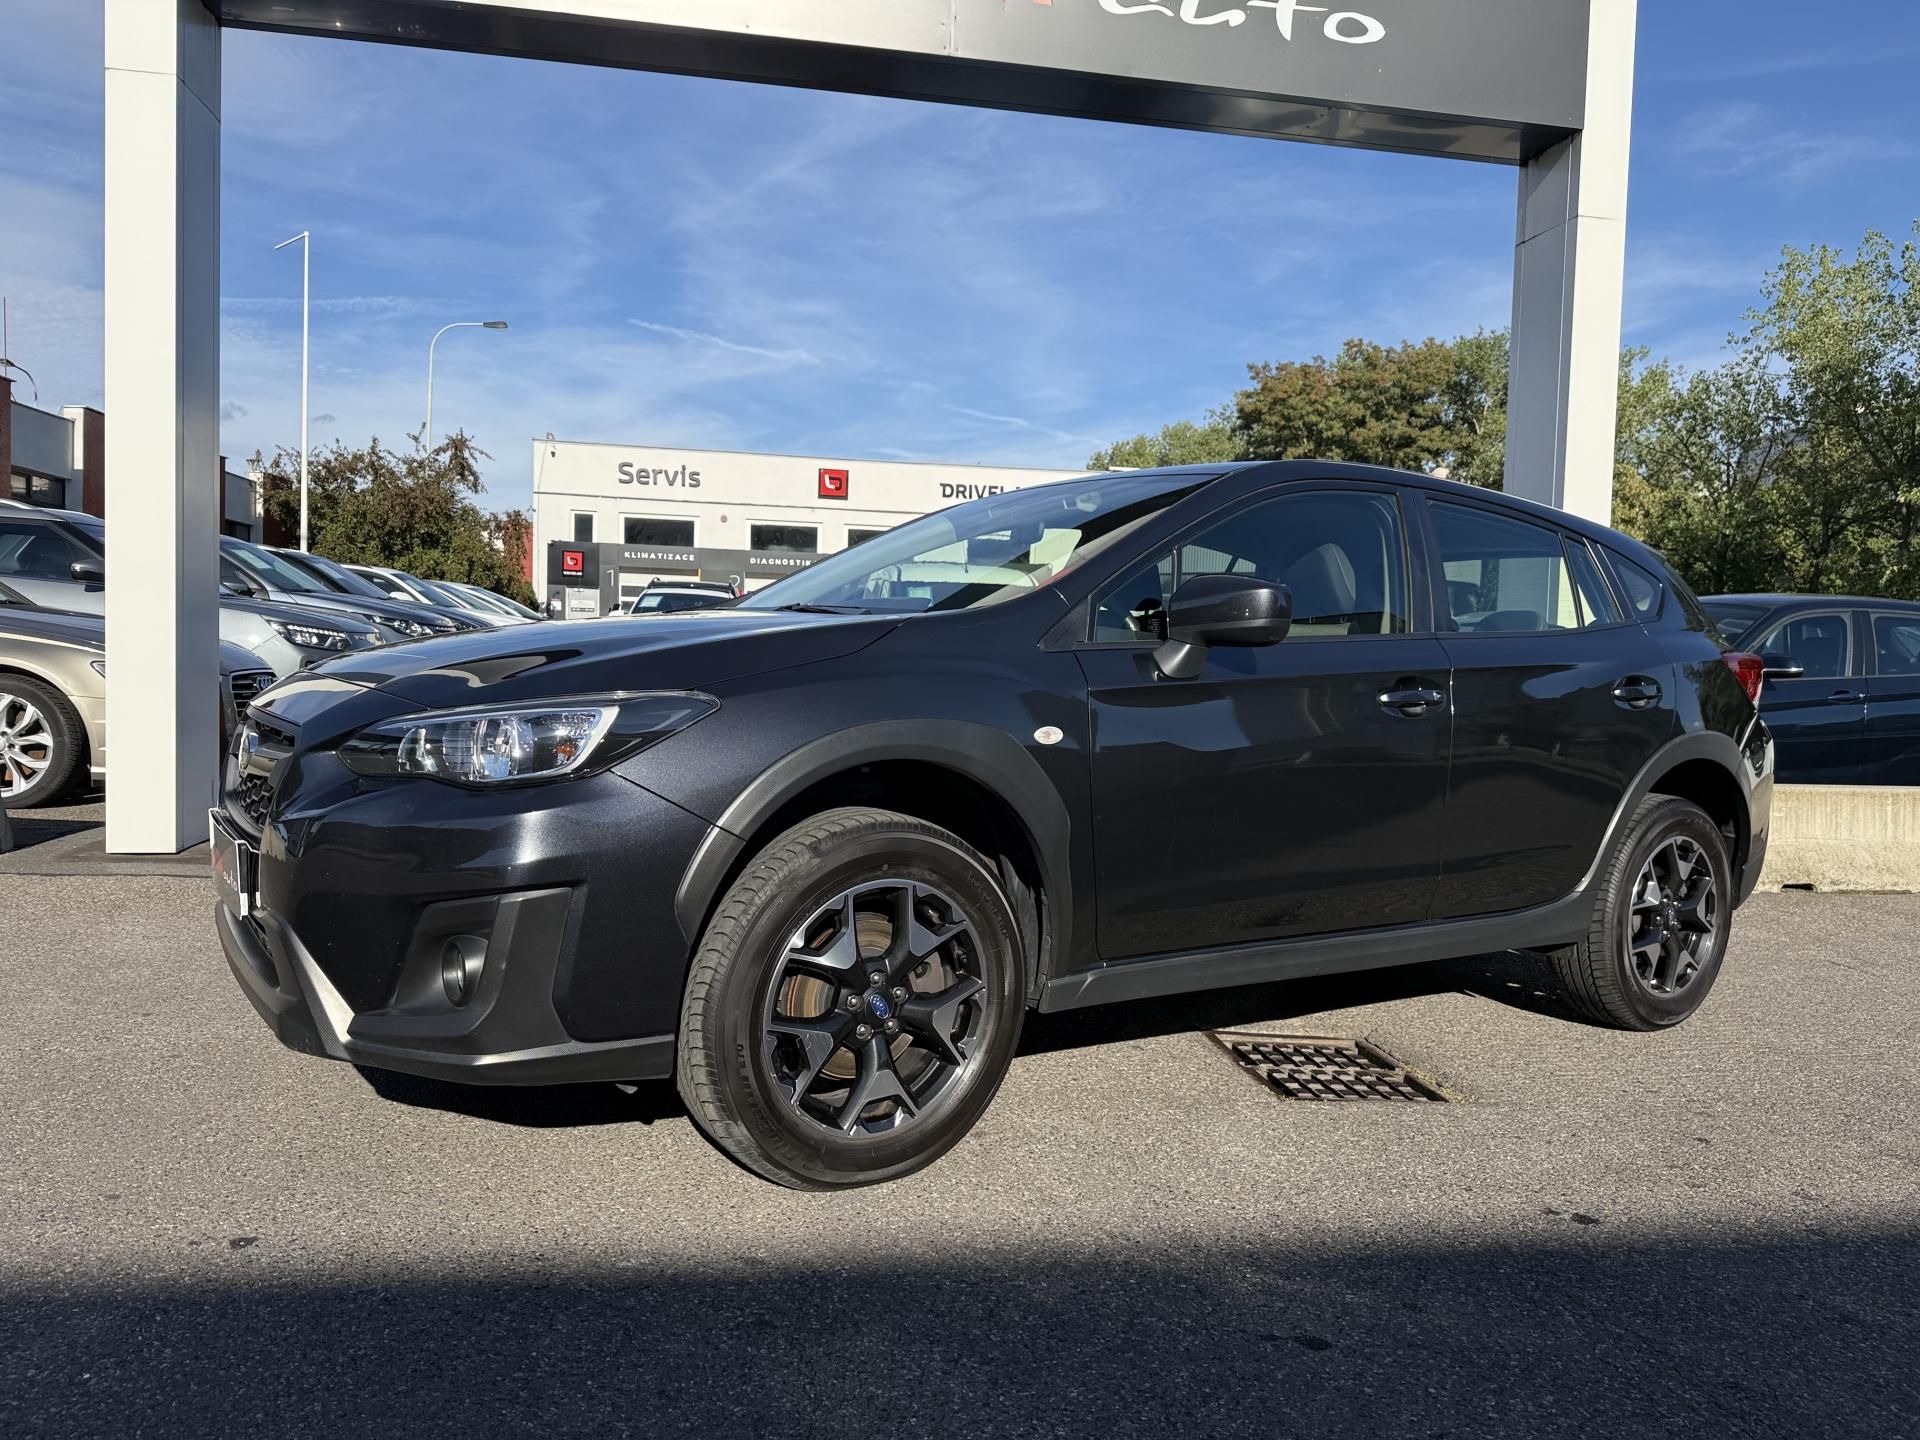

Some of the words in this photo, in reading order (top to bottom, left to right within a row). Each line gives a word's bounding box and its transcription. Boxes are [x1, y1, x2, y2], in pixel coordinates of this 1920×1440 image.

[618, 462, 701, 488] Servis
[624, 551, 695, 562] KLIMATIZACE
[749, 557, 817, 567] DIAGNOSTIK
[606, 569, 615, 587] 1
